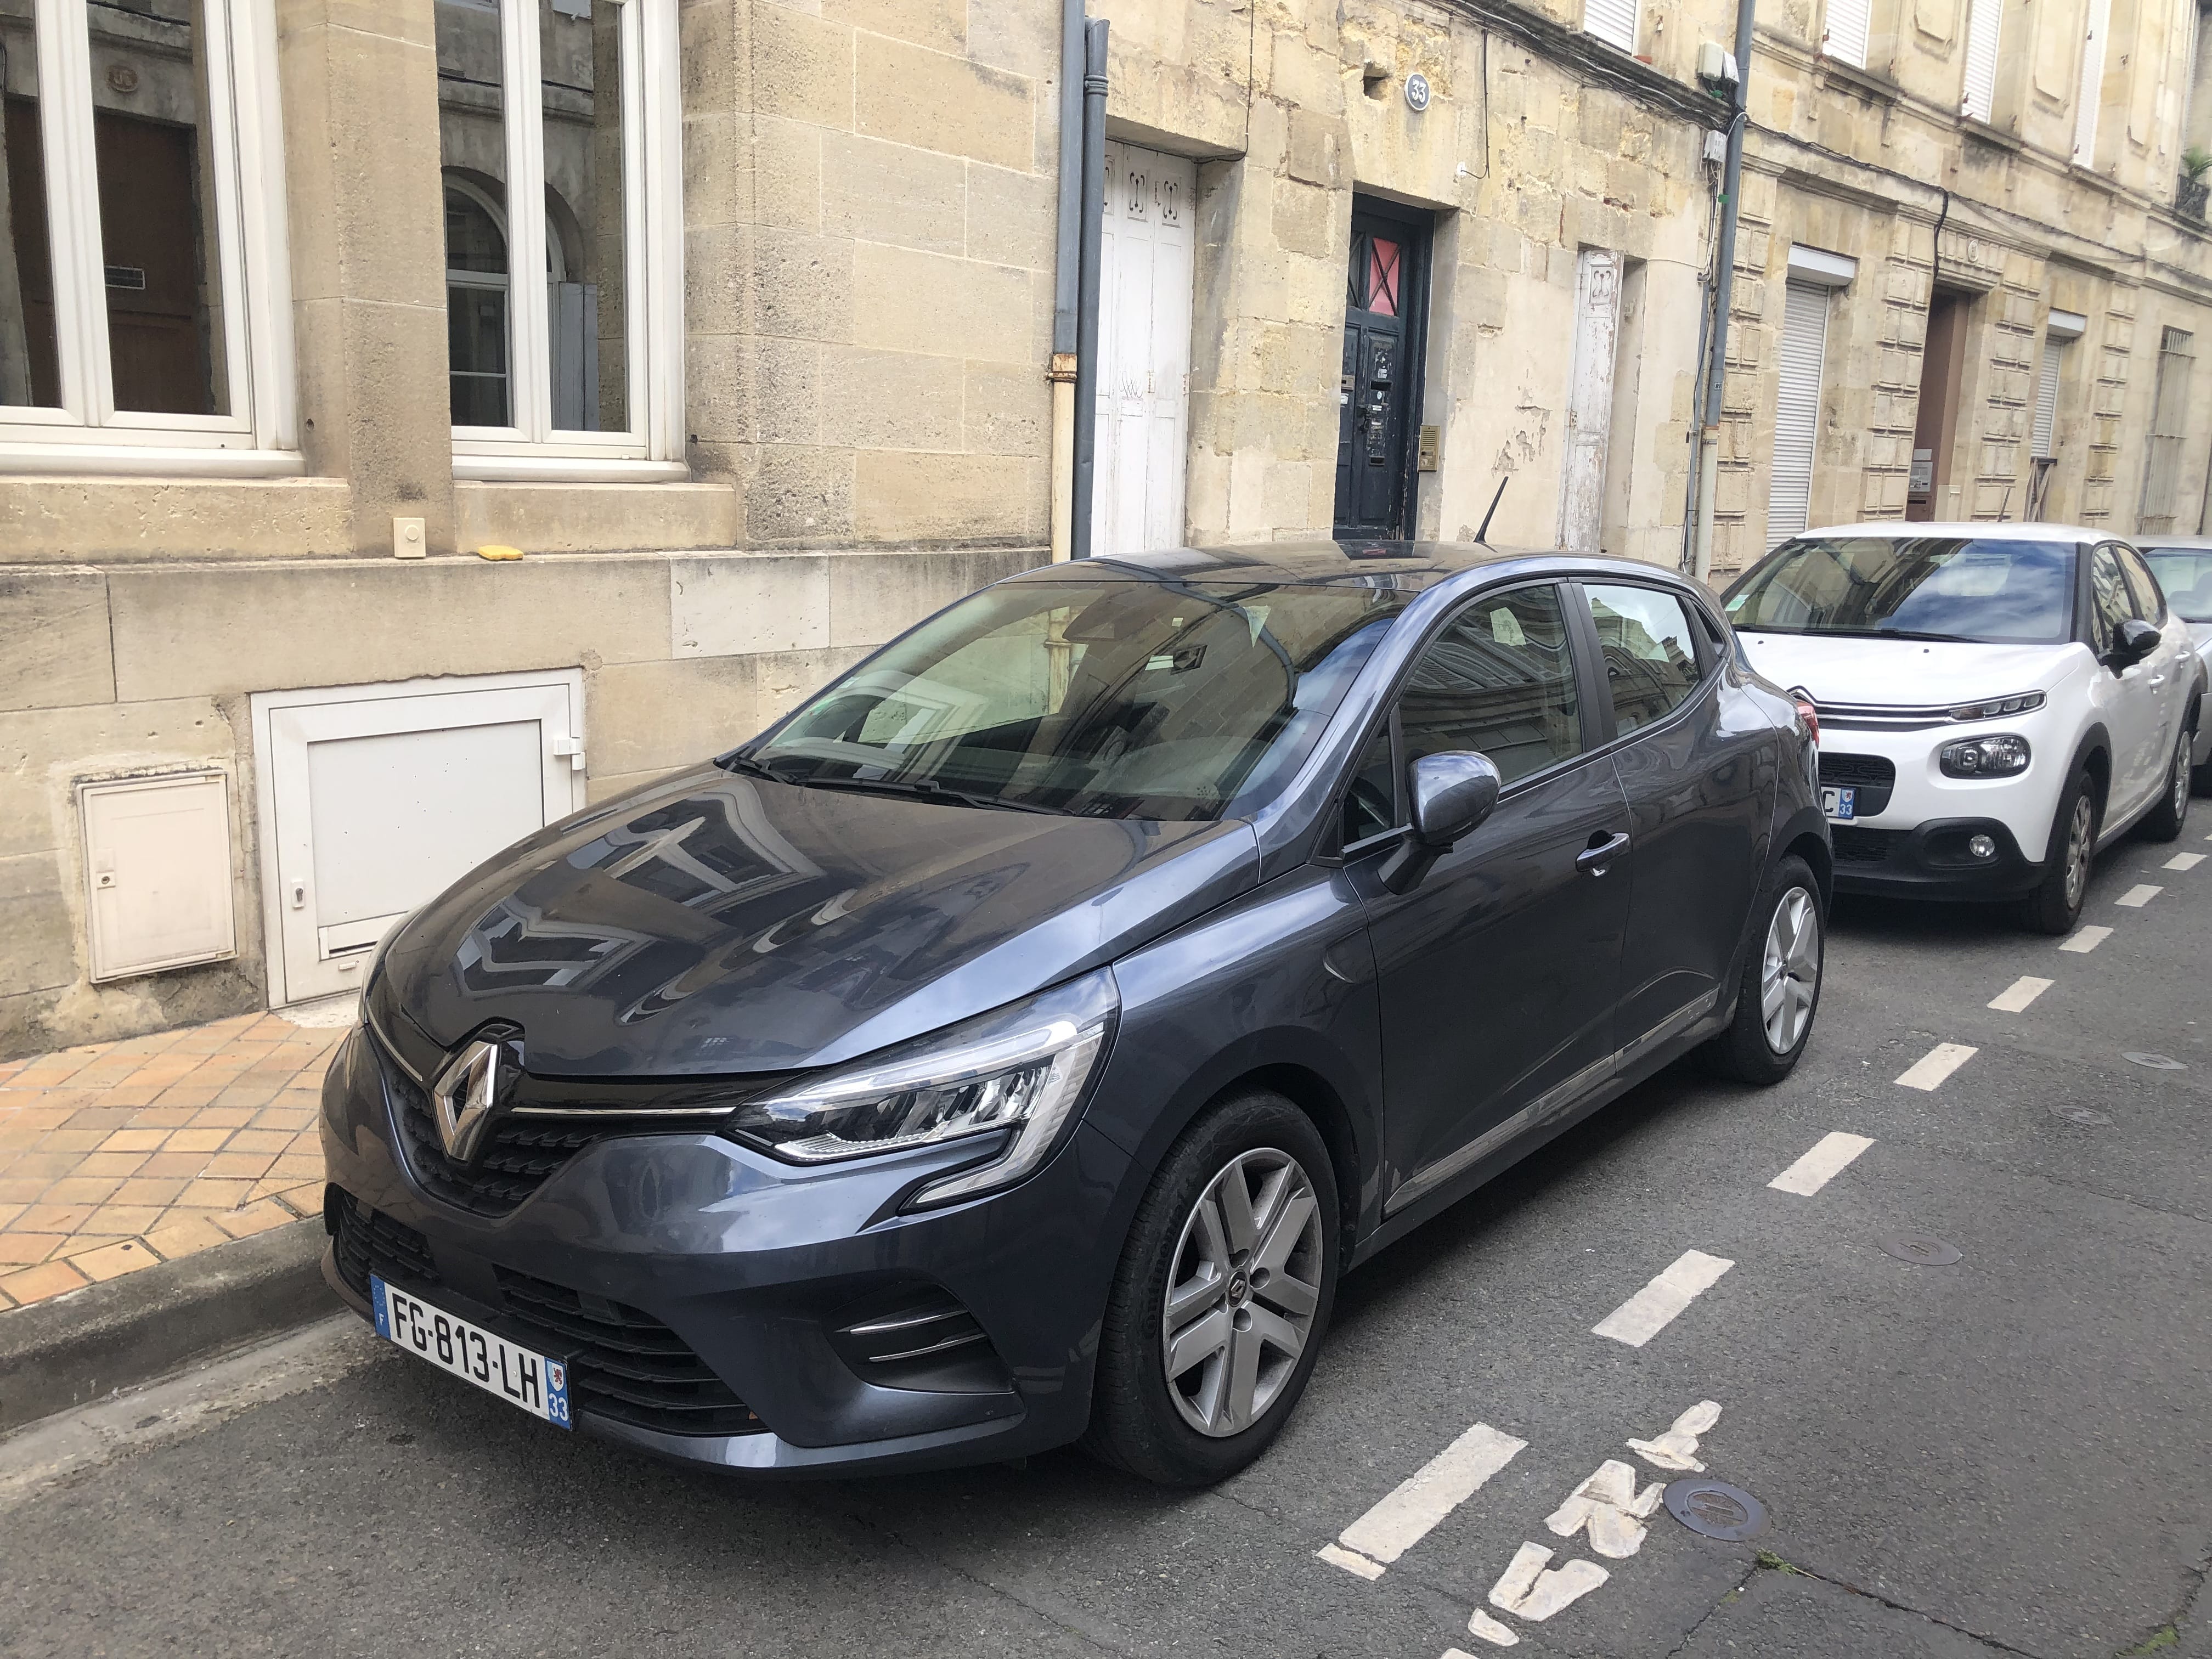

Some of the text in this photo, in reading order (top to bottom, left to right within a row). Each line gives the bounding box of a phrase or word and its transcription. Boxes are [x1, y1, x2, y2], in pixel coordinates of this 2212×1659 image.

[1411, 78, 1426, 103] 33
[1839, 803, 1853, 815] 33
[379, 1312, 385, 1326] F
[391, 1293, 540, 1409] FG-813-LH
[549, 1393, 568, 1421] 33
